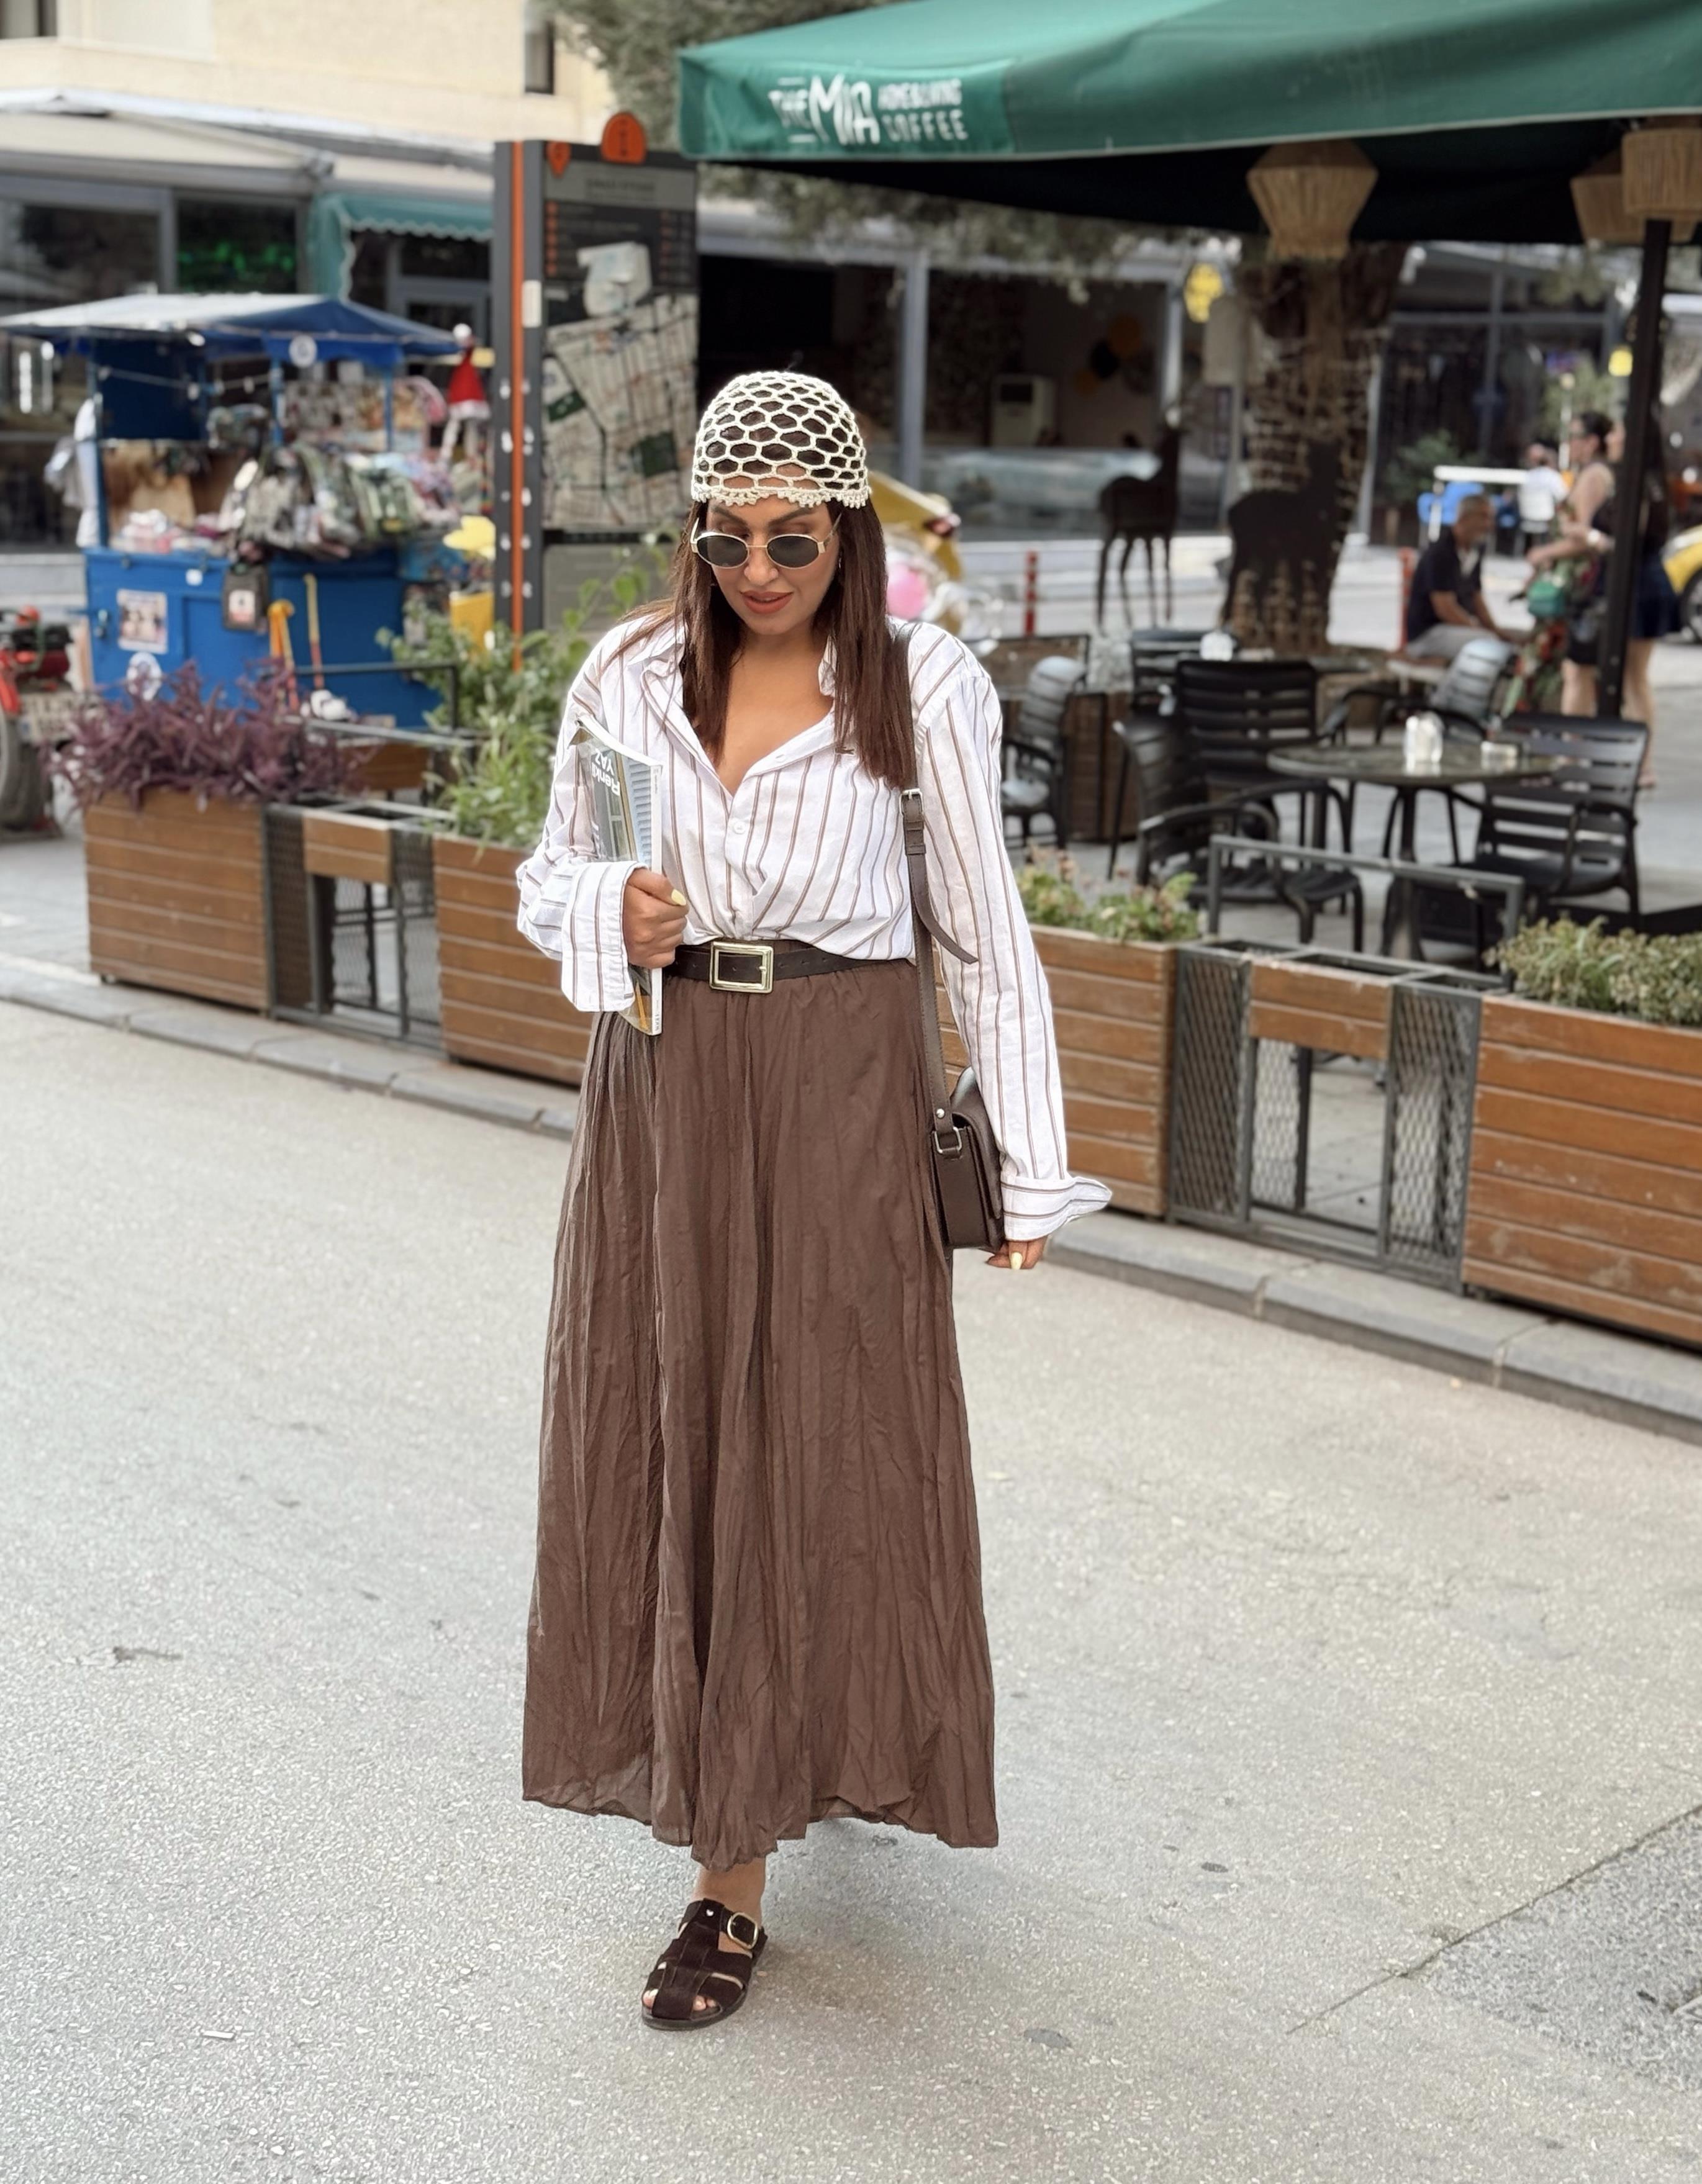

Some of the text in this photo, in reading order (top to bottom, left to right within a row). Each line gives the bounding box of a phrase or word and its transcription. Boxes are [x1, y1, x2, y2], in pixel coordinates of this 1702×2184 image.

[768, 73, 880, 145] THE MIA
[881, 109, 969, 142] COFFEE
[595, 748, 614, 775] YAZ
